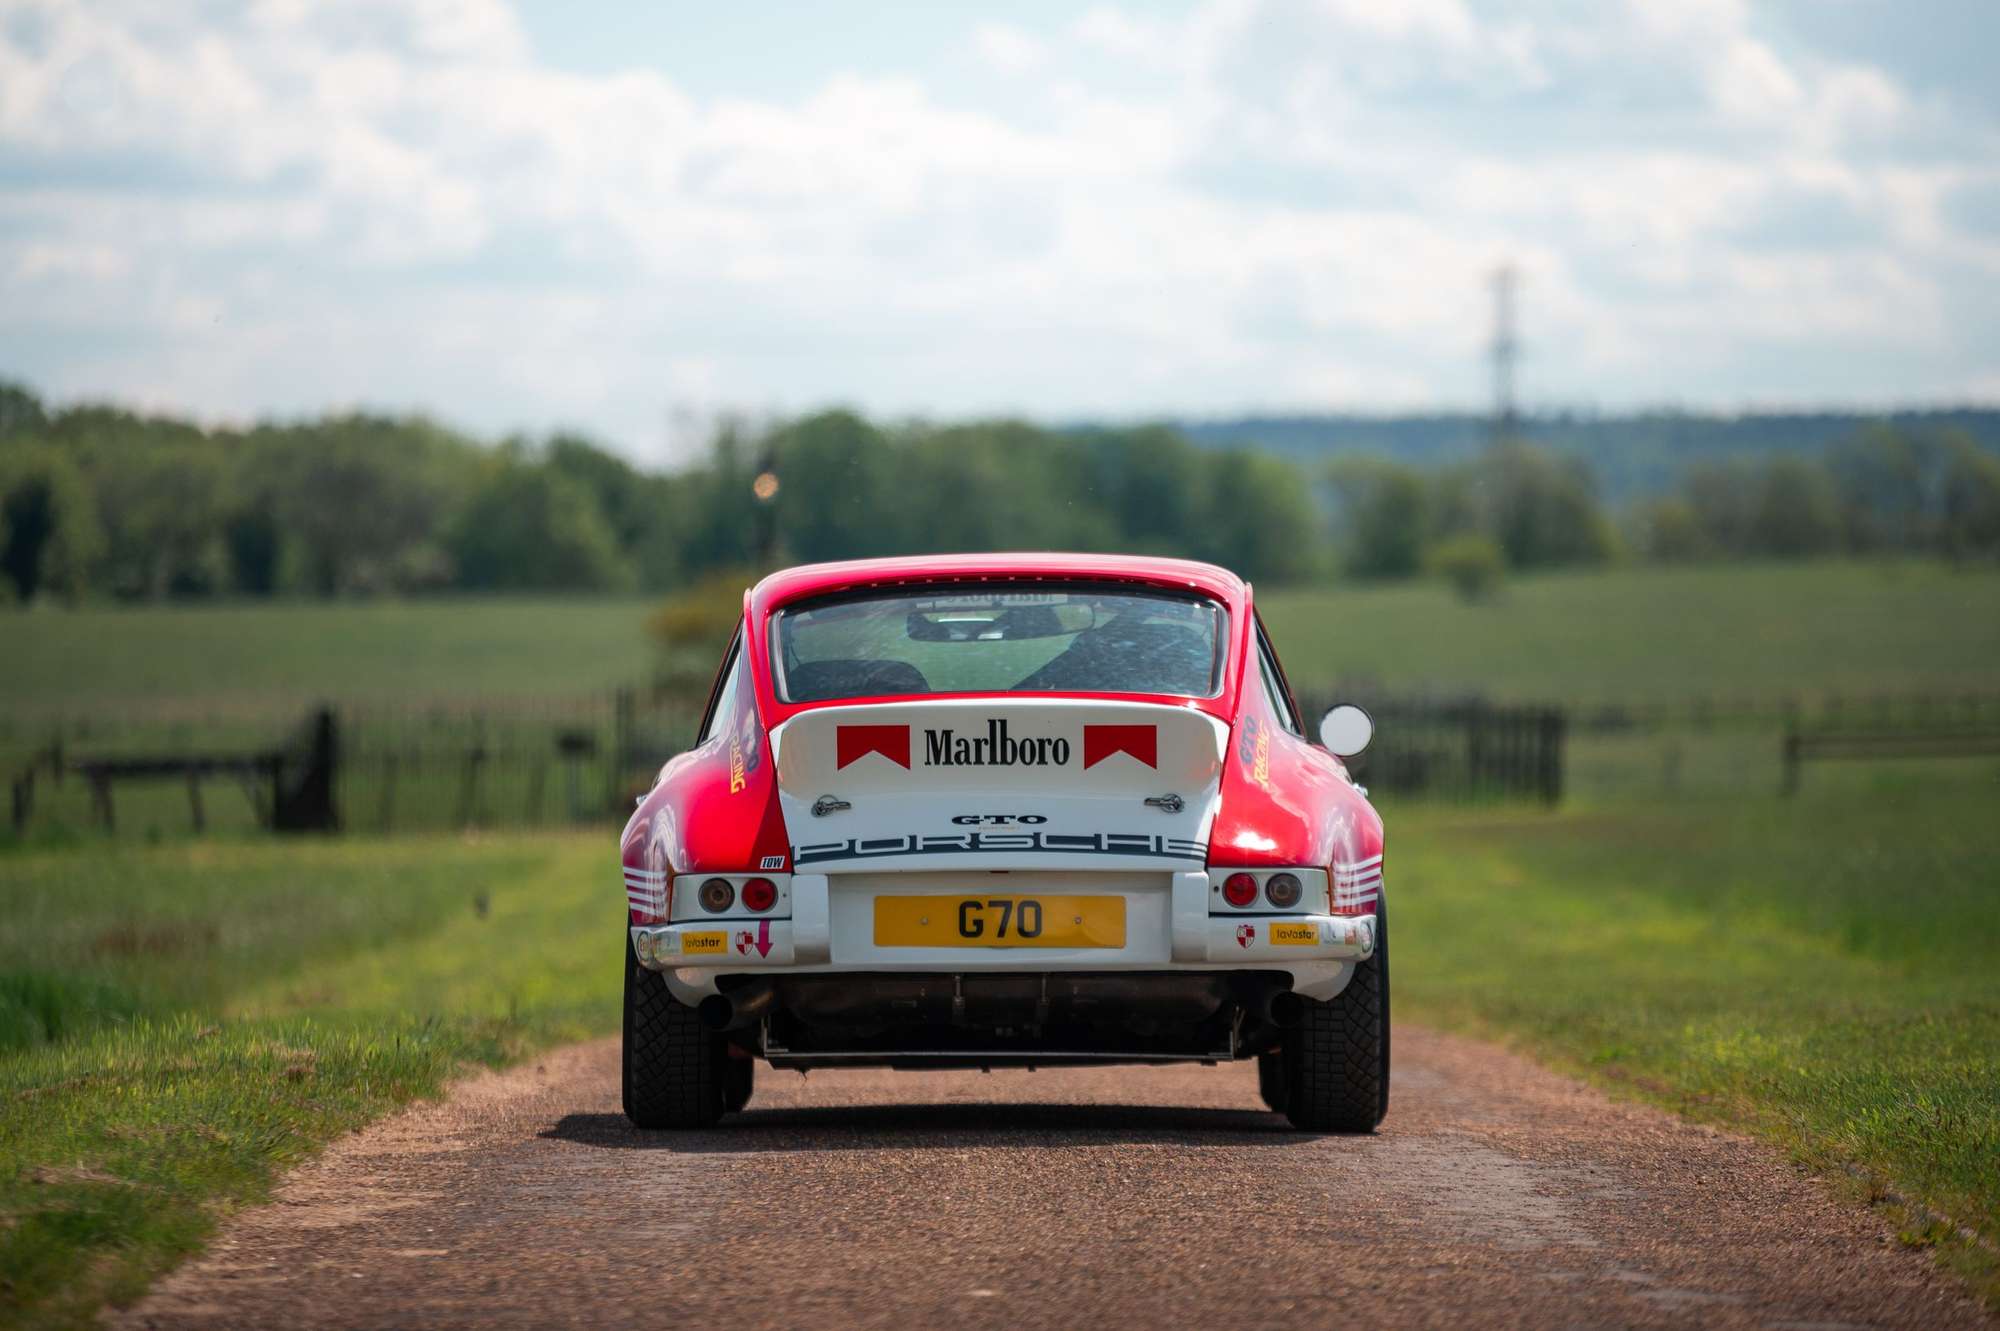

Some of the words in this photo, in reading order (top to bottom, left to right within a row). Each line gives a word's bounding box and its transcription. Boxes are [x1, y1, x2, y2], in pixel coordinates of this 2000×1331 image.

[925, 719, 1070, 766] Marlboro
[951, 815, 1048, 825] GTO
[793, 832, 1207, 862] PORSCHE
[762, 857, 784, 868] TOW
[959, 900, 1042, 938] G70
